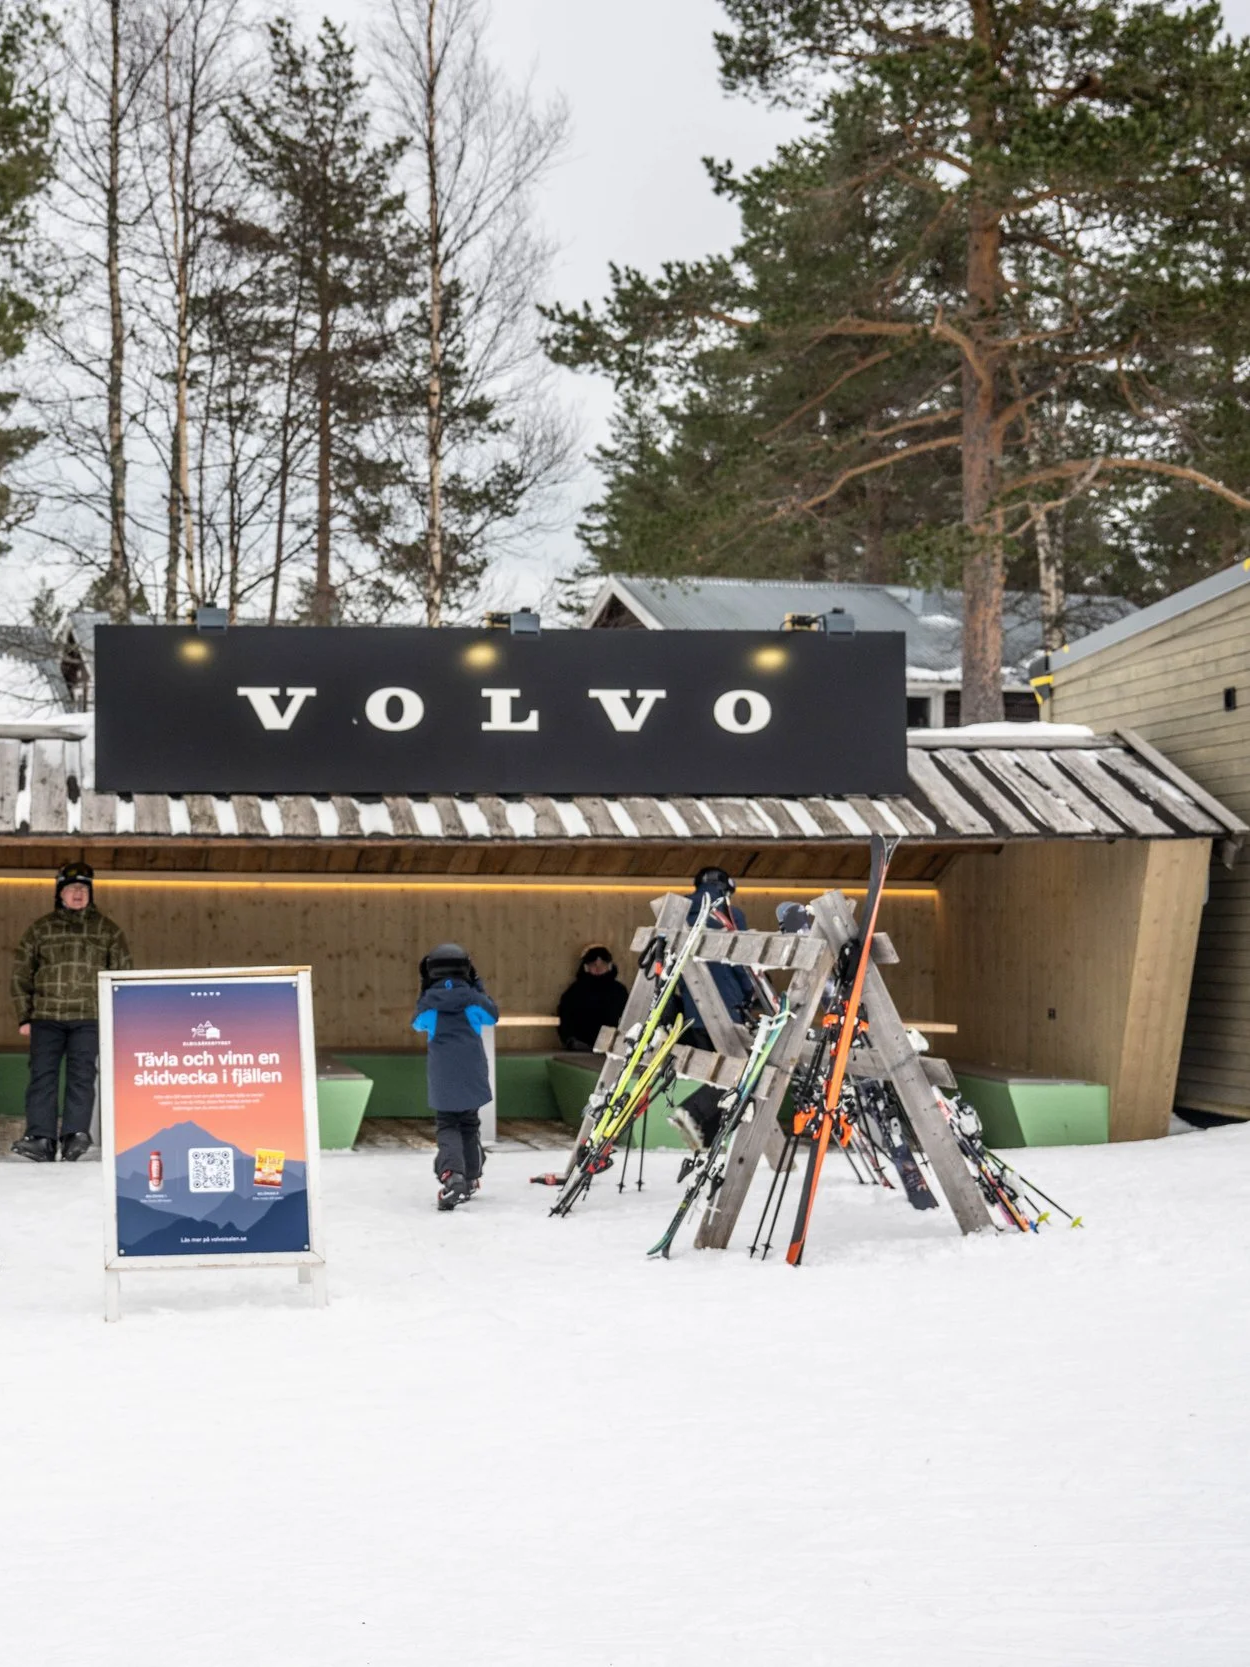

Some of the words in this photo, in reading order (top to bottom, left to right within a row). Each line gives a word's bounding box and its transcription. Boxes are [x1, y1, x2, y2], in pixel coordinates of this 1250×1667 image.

[236, 685, 775, 734] VOLVO
[134, 1051, 178, 1068] Tävla
[183, 1051, 214, 1066] och
[219, 1050, 253, 1065] vinn
[258, 1052, 280, 1065] en
[134, 1069, 218, 1086] skidvecka
[222, 1069, 227, 1084] i
[231, 1068, 282, 1087] fjällen
[203, 1236, 210, 1244] på
